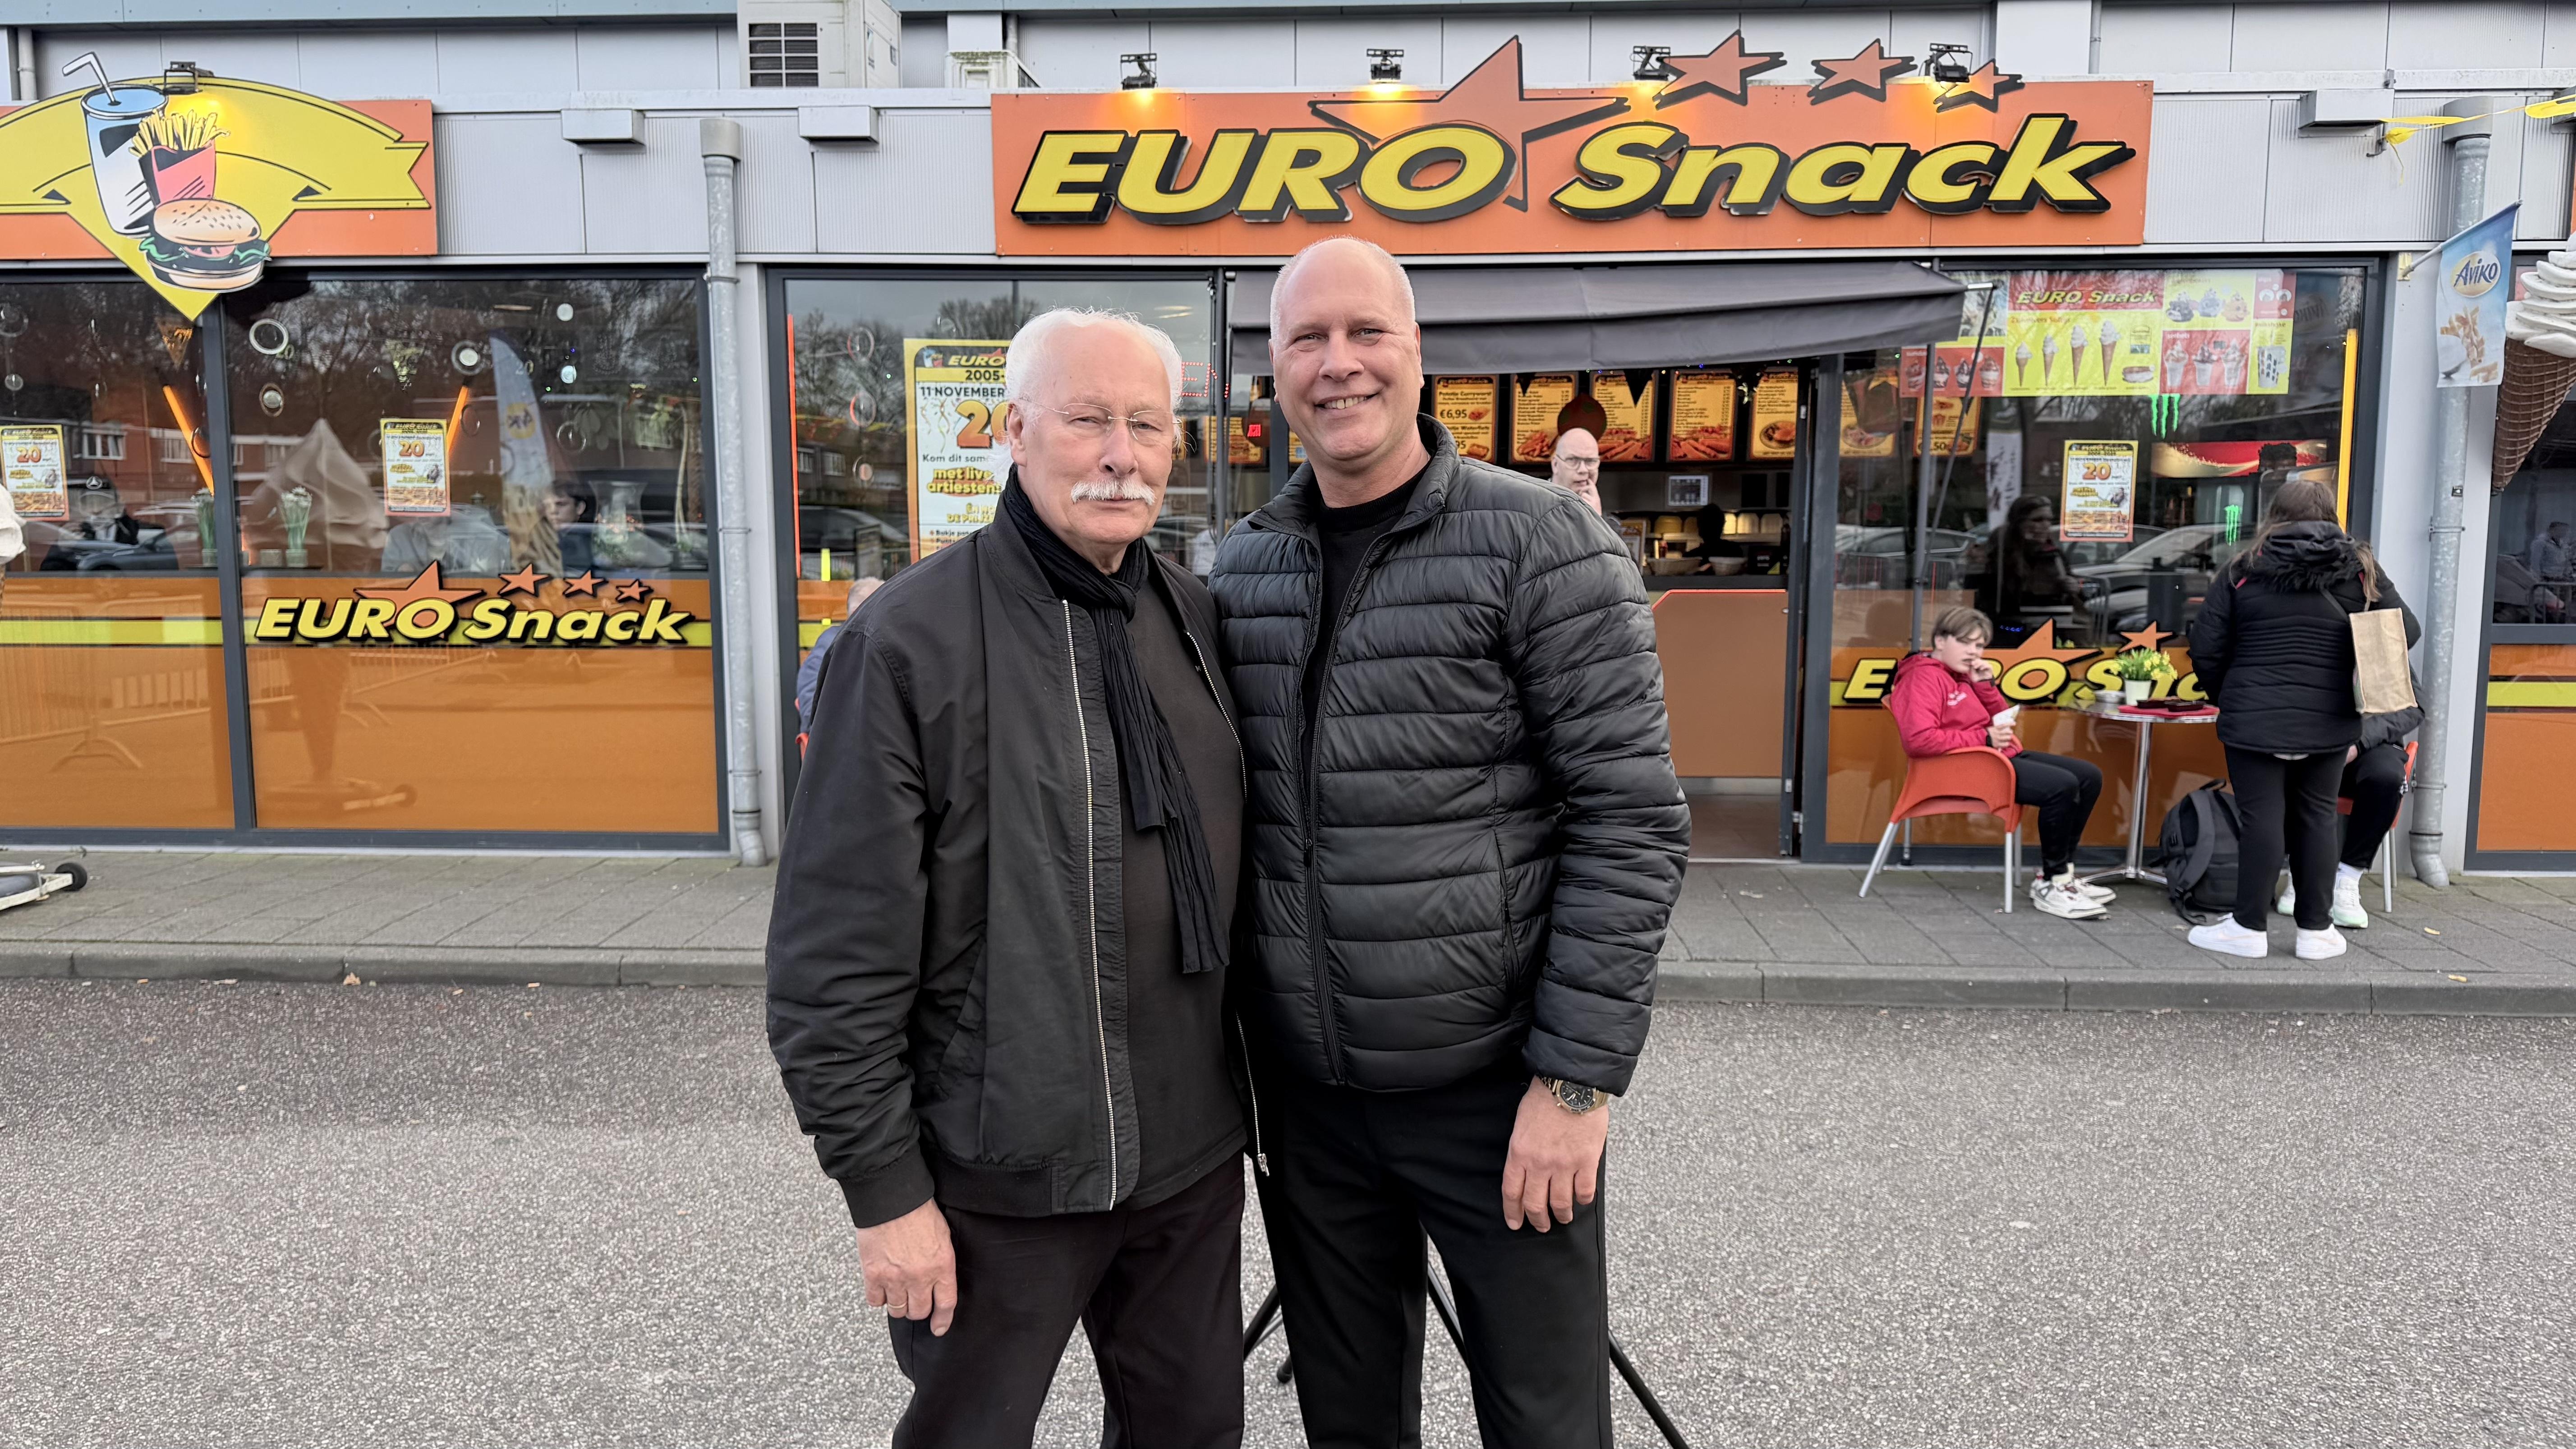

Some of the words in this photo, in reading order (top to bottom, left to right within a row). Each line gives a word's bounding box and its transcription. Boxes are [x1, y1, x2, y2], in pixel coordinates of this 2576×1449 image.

[1013, 123, 1512, 220] EURO
[1550, 114, 2130, 216] Snack
[2454, 258, 2498, 287] Aviko
[2017, 290, 2083, 304] EURO
[2088, 290, 2157, 304] Snack
[948, 355, 1006, 367] EURO
[965, 370, 1005, 381] 2005-
[920, 387, 931, 397] 11
[935, 386, 1005, 397] NOVEMBER
[1440, 409, 1467, 420] €6,95
[16, 446, 42, 463] 20
[399, 440, 425, 457] 20
[923, 454, 945, 462] Kom
[948, 454, 961, 462] dit
[933, 468, 964, 480] met
[2082, 462, 2111, 480] 20
[254, 597, 456, 642] EURO
[464, 597, 693, 642] Snack
